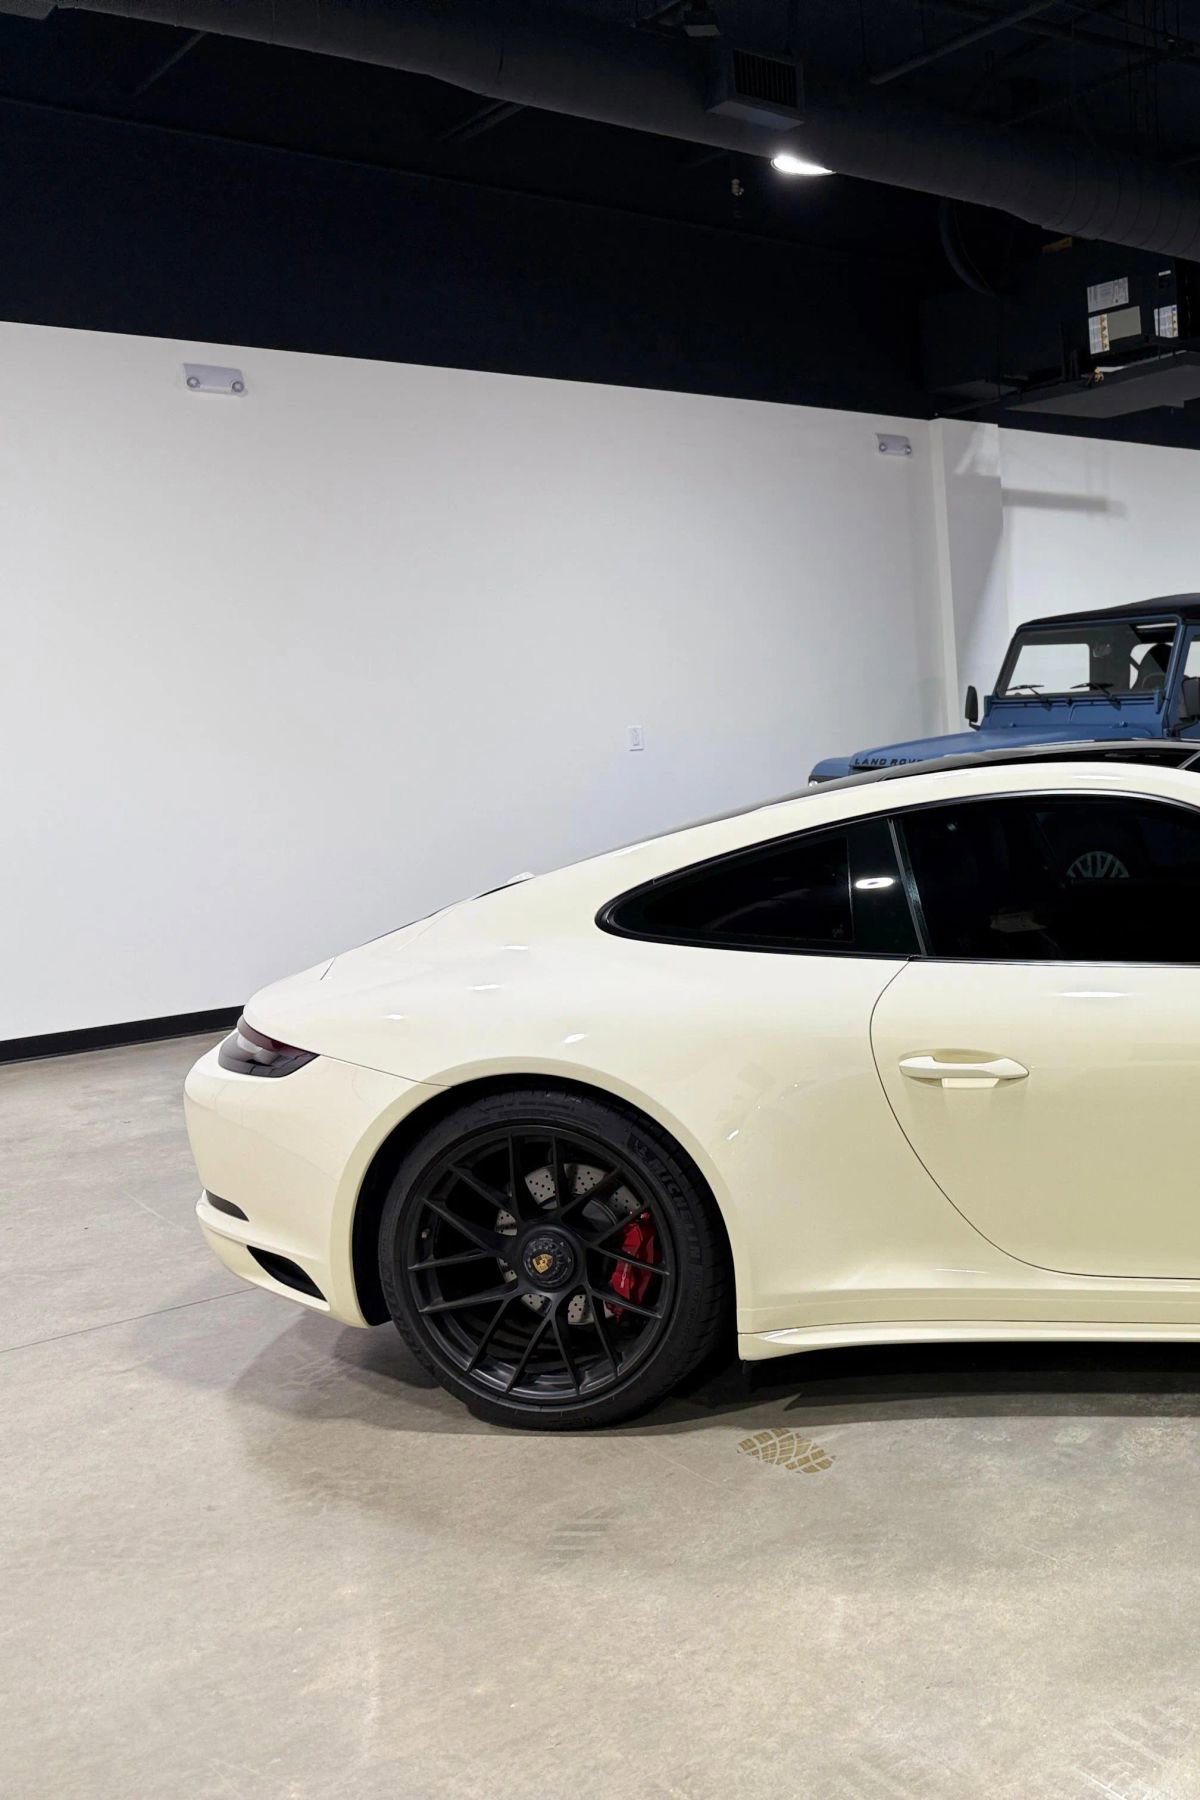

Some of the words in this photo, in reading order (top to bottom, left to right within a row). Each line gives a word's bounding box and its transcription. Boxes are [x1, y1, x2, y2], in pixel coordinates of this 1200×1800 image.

[855, 758, 887, 766] LAND
[890, 758, 923, 766] ROV
[648, 1156, 700, 1261] MICHELIN
